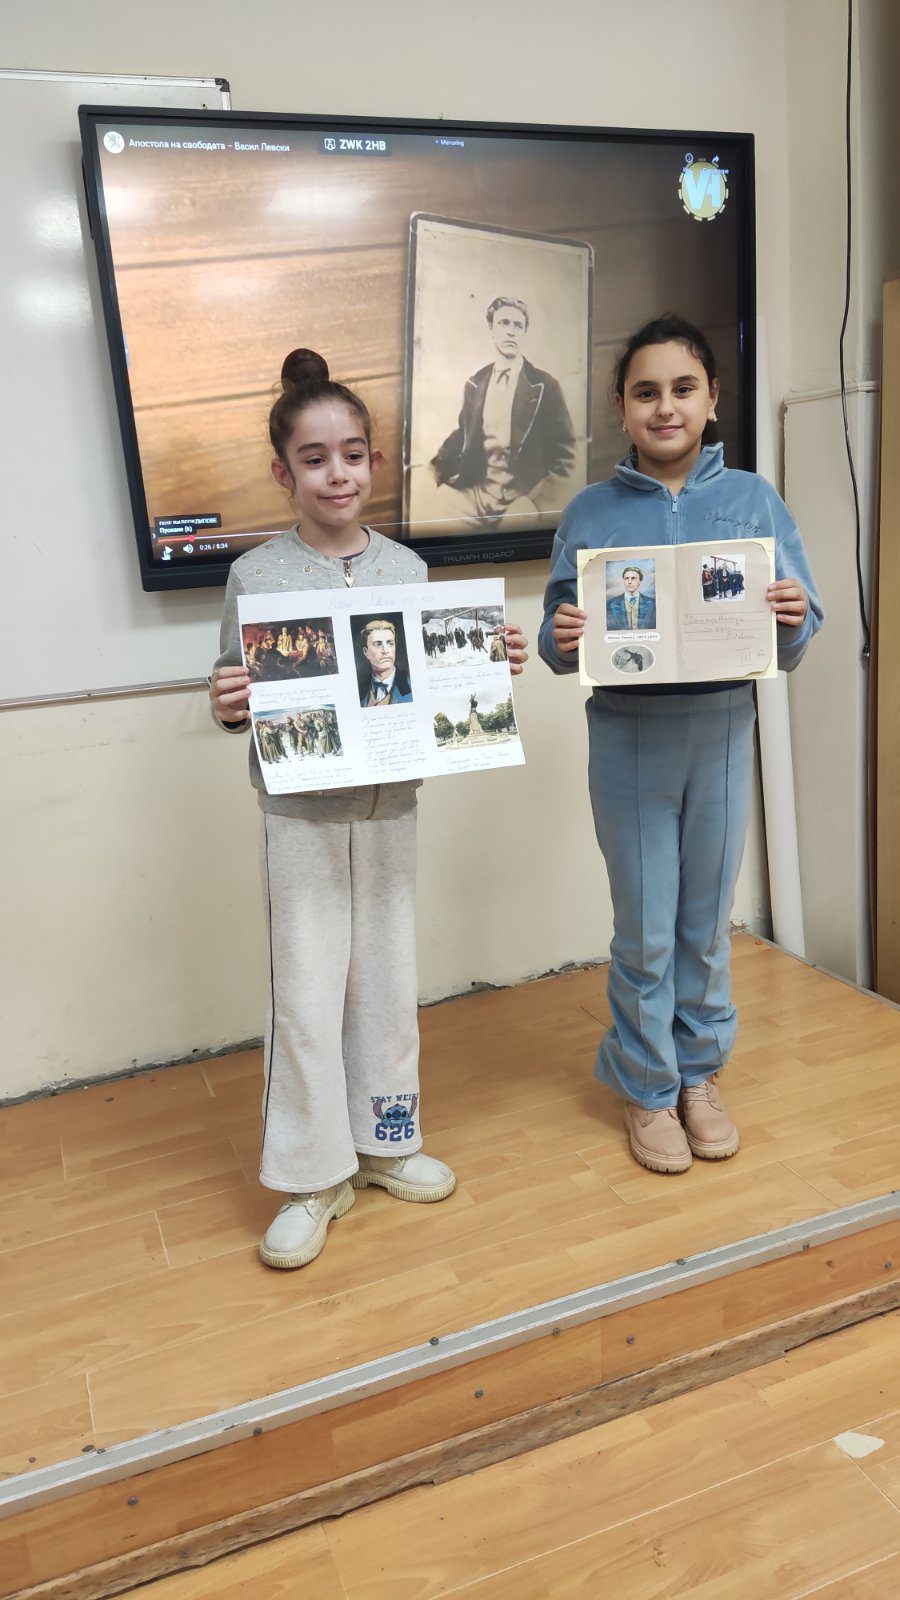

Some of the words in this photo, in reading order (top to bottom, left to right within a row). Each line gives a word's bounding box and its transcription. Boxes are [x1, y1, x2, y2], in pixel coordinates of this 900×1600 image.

[129, 138, 169, 148] Апостола
[170, 141, 181, 149] на
[183, 140, 225, 150] свободата
[234, 141, 259, 151] Васил
[261, 142, 290, 152] Левски
[339, 139, 363, 150] ZWK
[365, 140, 387, 151] 2HB
[440, 138, 465, 147] Mirroring
[443, 552, 480, 563] TRIUMPH
[374, 1120, 415, 1142] 626
